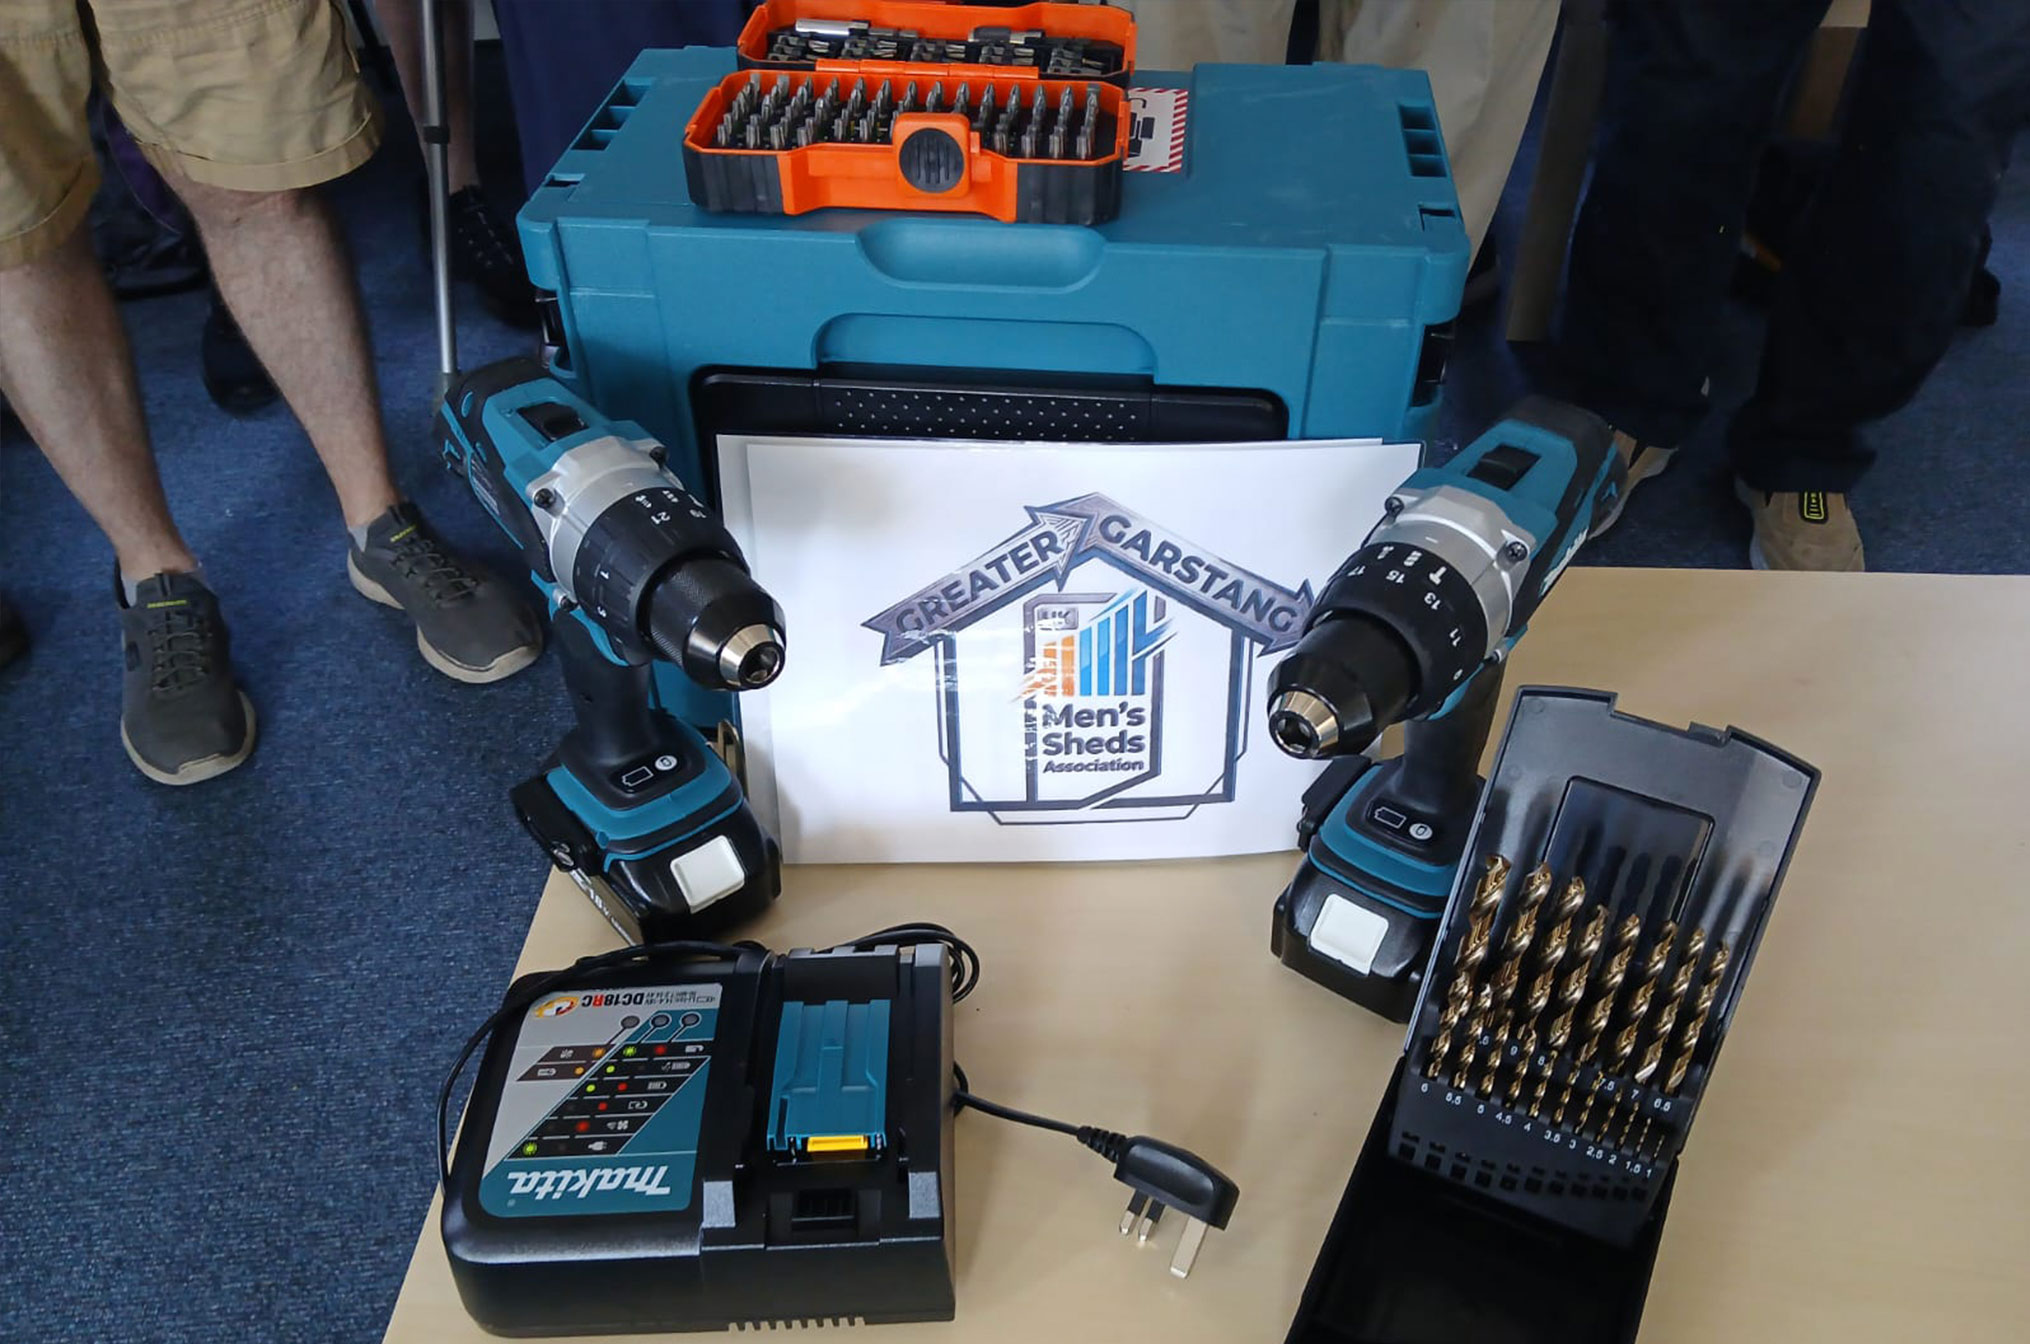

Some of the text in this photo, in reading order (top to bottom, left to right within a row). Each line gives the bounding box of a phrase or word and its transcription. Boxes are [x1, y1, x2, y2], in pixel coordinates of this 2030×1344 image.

[895, 529, 1064, 633] GREATER
[1099, 513, 1297, 636] GARSTANG
[1385, 569, 1406, 584] 15
[1423, 591, 1442, 610] 13
[1042, 702, 1146, 728] Men's
[1042, 732, 1146, 756] Sheds
[1043, 758, 1145, 774] Association
[580, 992, 645, 1008] DC18RC
[1537, 1055, 1545, 1066] 8
[1631, 1089, 1639, 1099] 7
[1420, 1082, 1429, 1093] 6
[1477, 1104, 1485, 1115] 5
[1523, 1122, 1531, 1132] 4
[1568, 1140, 1577, 1149] 3
[1608, 1154, 1617, 1165] 2
[1646, 1168, 1652, 1178] 1
